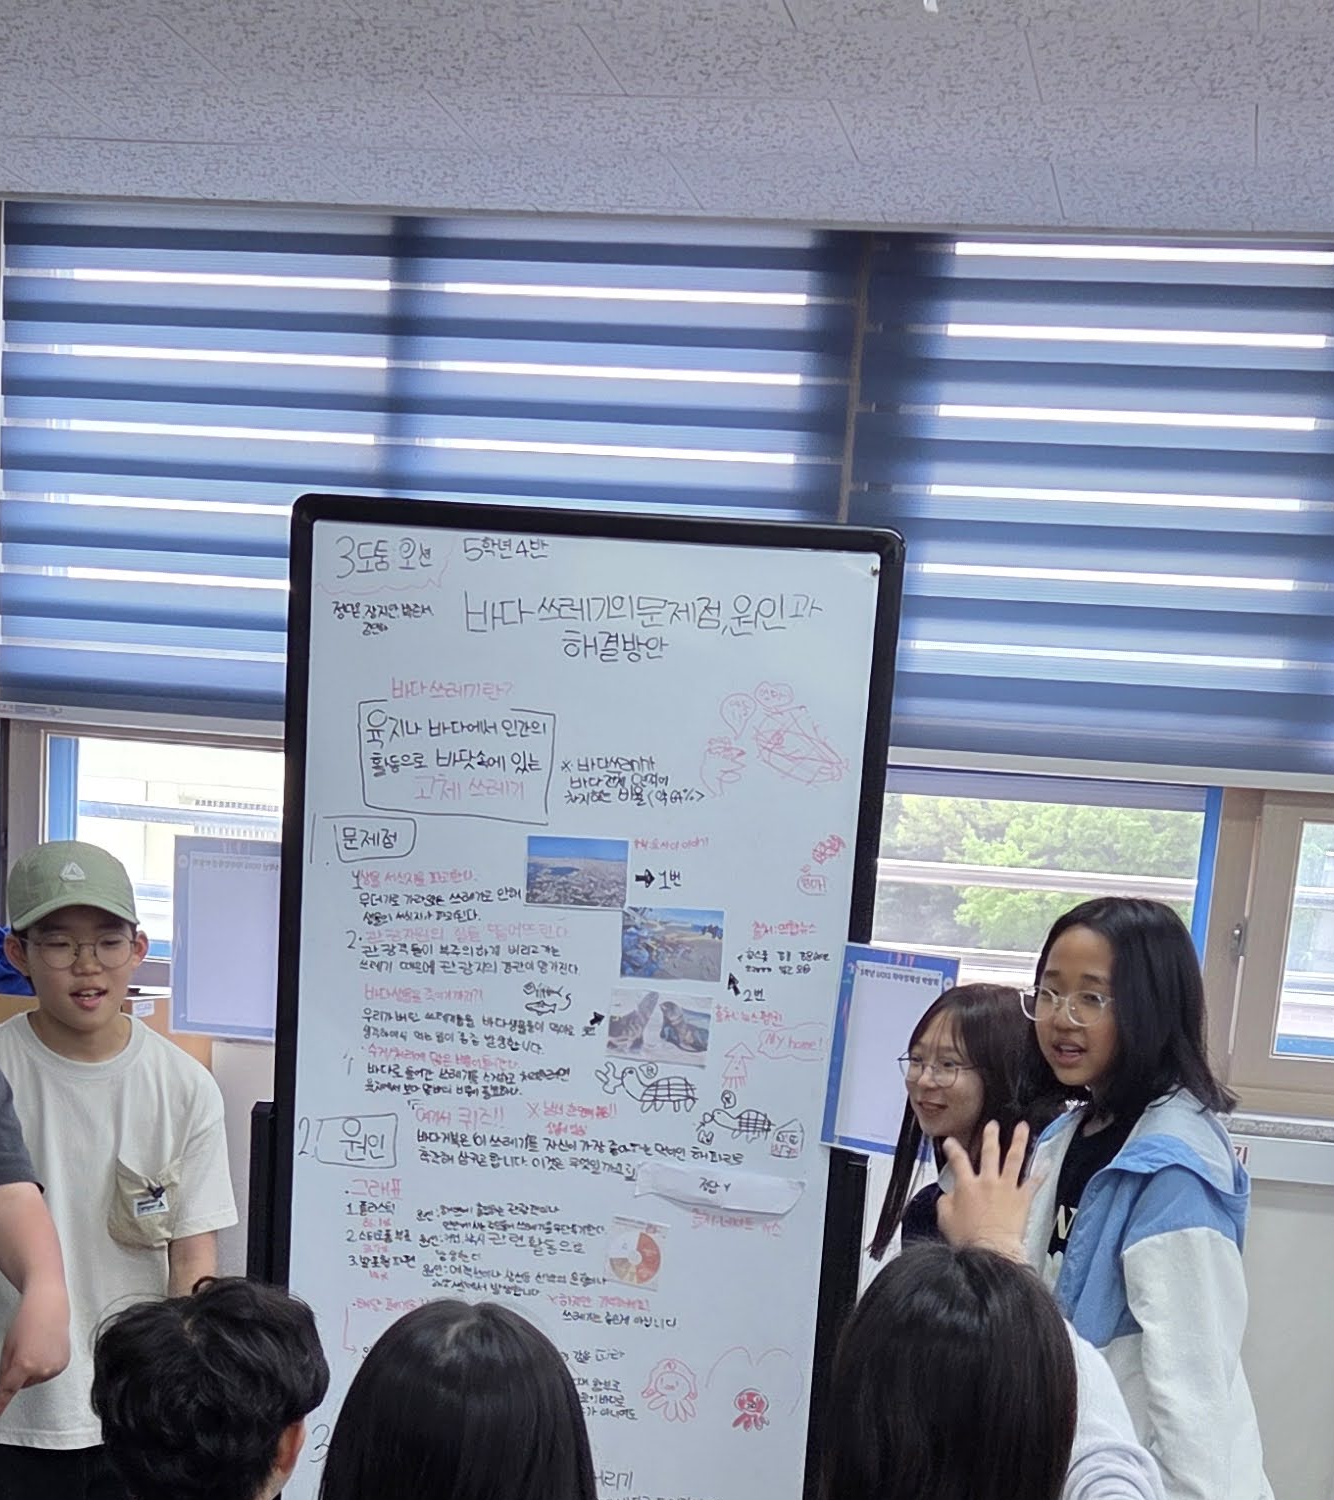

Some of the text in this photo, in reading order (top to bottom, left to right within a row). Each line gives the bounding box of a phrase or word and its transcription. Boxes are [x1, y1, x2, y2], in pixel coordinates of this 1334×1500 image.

[366, 708, 547, 749] 육지나 바다에서 인간의
[341, 826, 398, 851] 문제점
[339, 1118, 385, 1161] 원인
